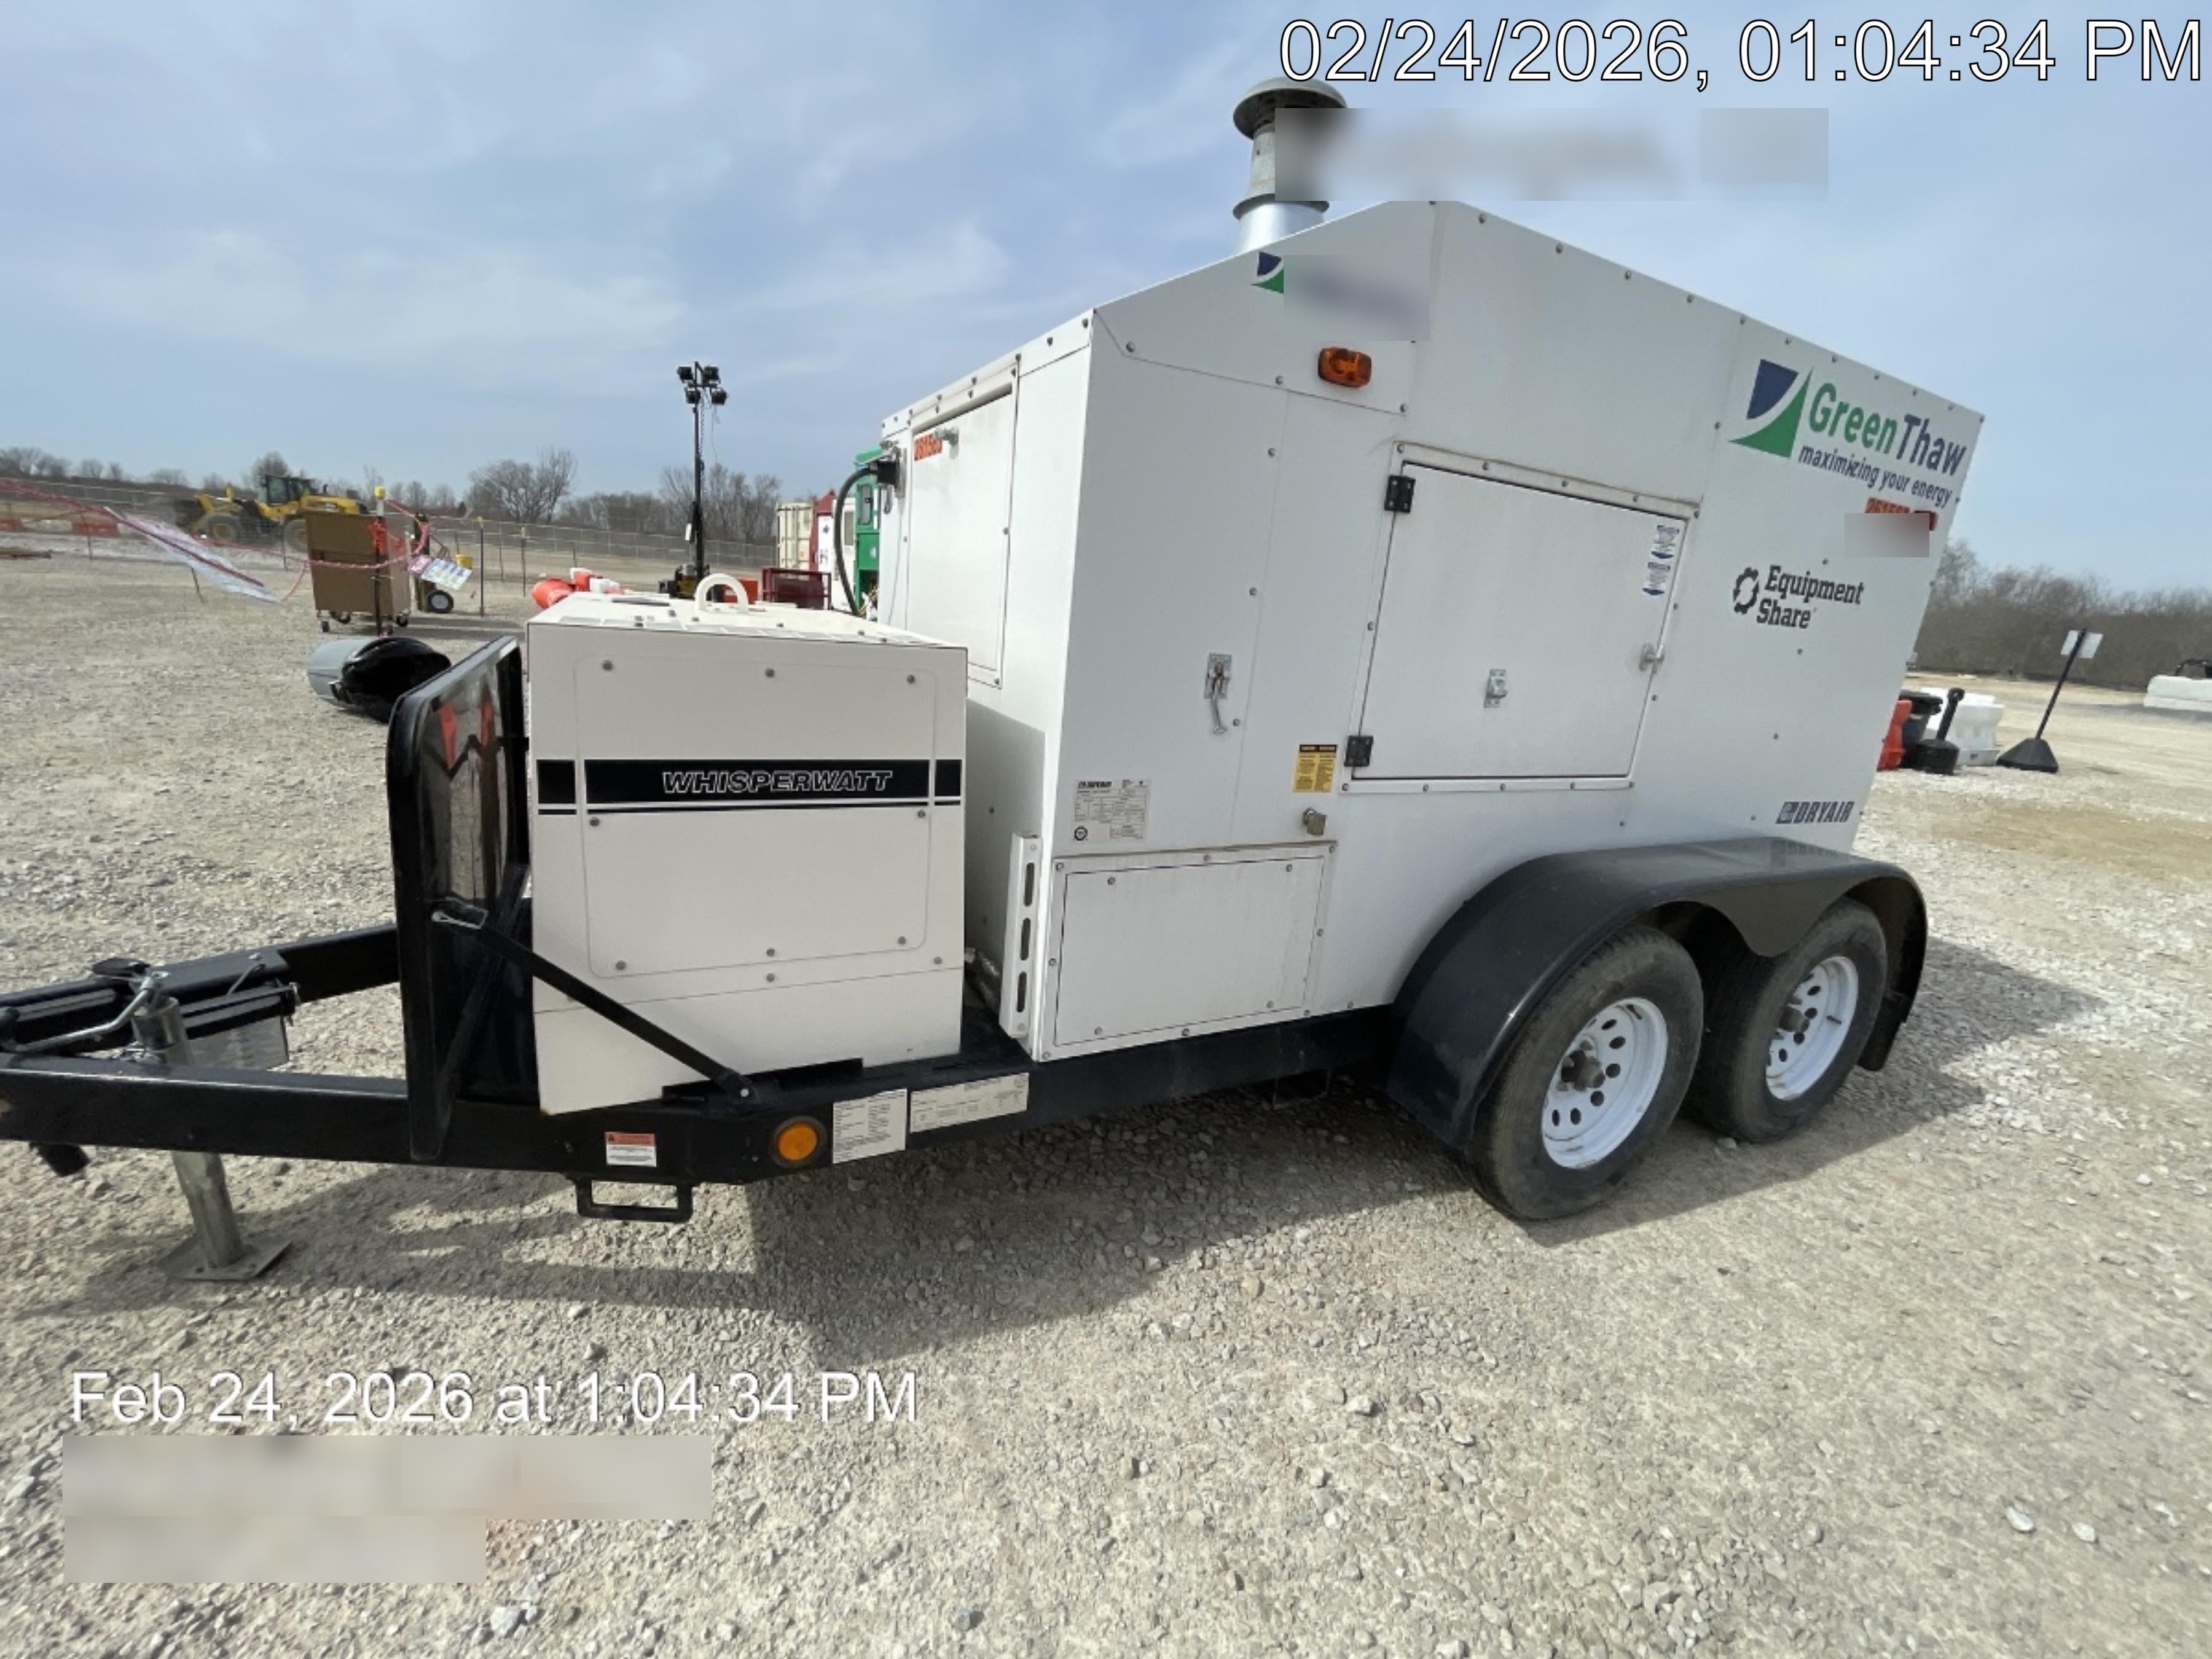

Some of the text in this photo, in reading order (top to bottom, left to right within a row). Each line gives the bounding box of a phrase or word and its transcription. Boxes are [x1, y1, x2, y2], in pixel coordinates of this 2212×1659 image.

[1798, 445, 1880, 489] maximizing
[1878, 469, 1910, 492] your
[1911, 479, 1953, 509] energy
[1764, 564, 1864, 605] Equipment
[1756, 597, 1811, 629] Share
[662, 770, 893, 794] WHISPERWATT
[1793, 801, 1855, 824] DRYAIR
